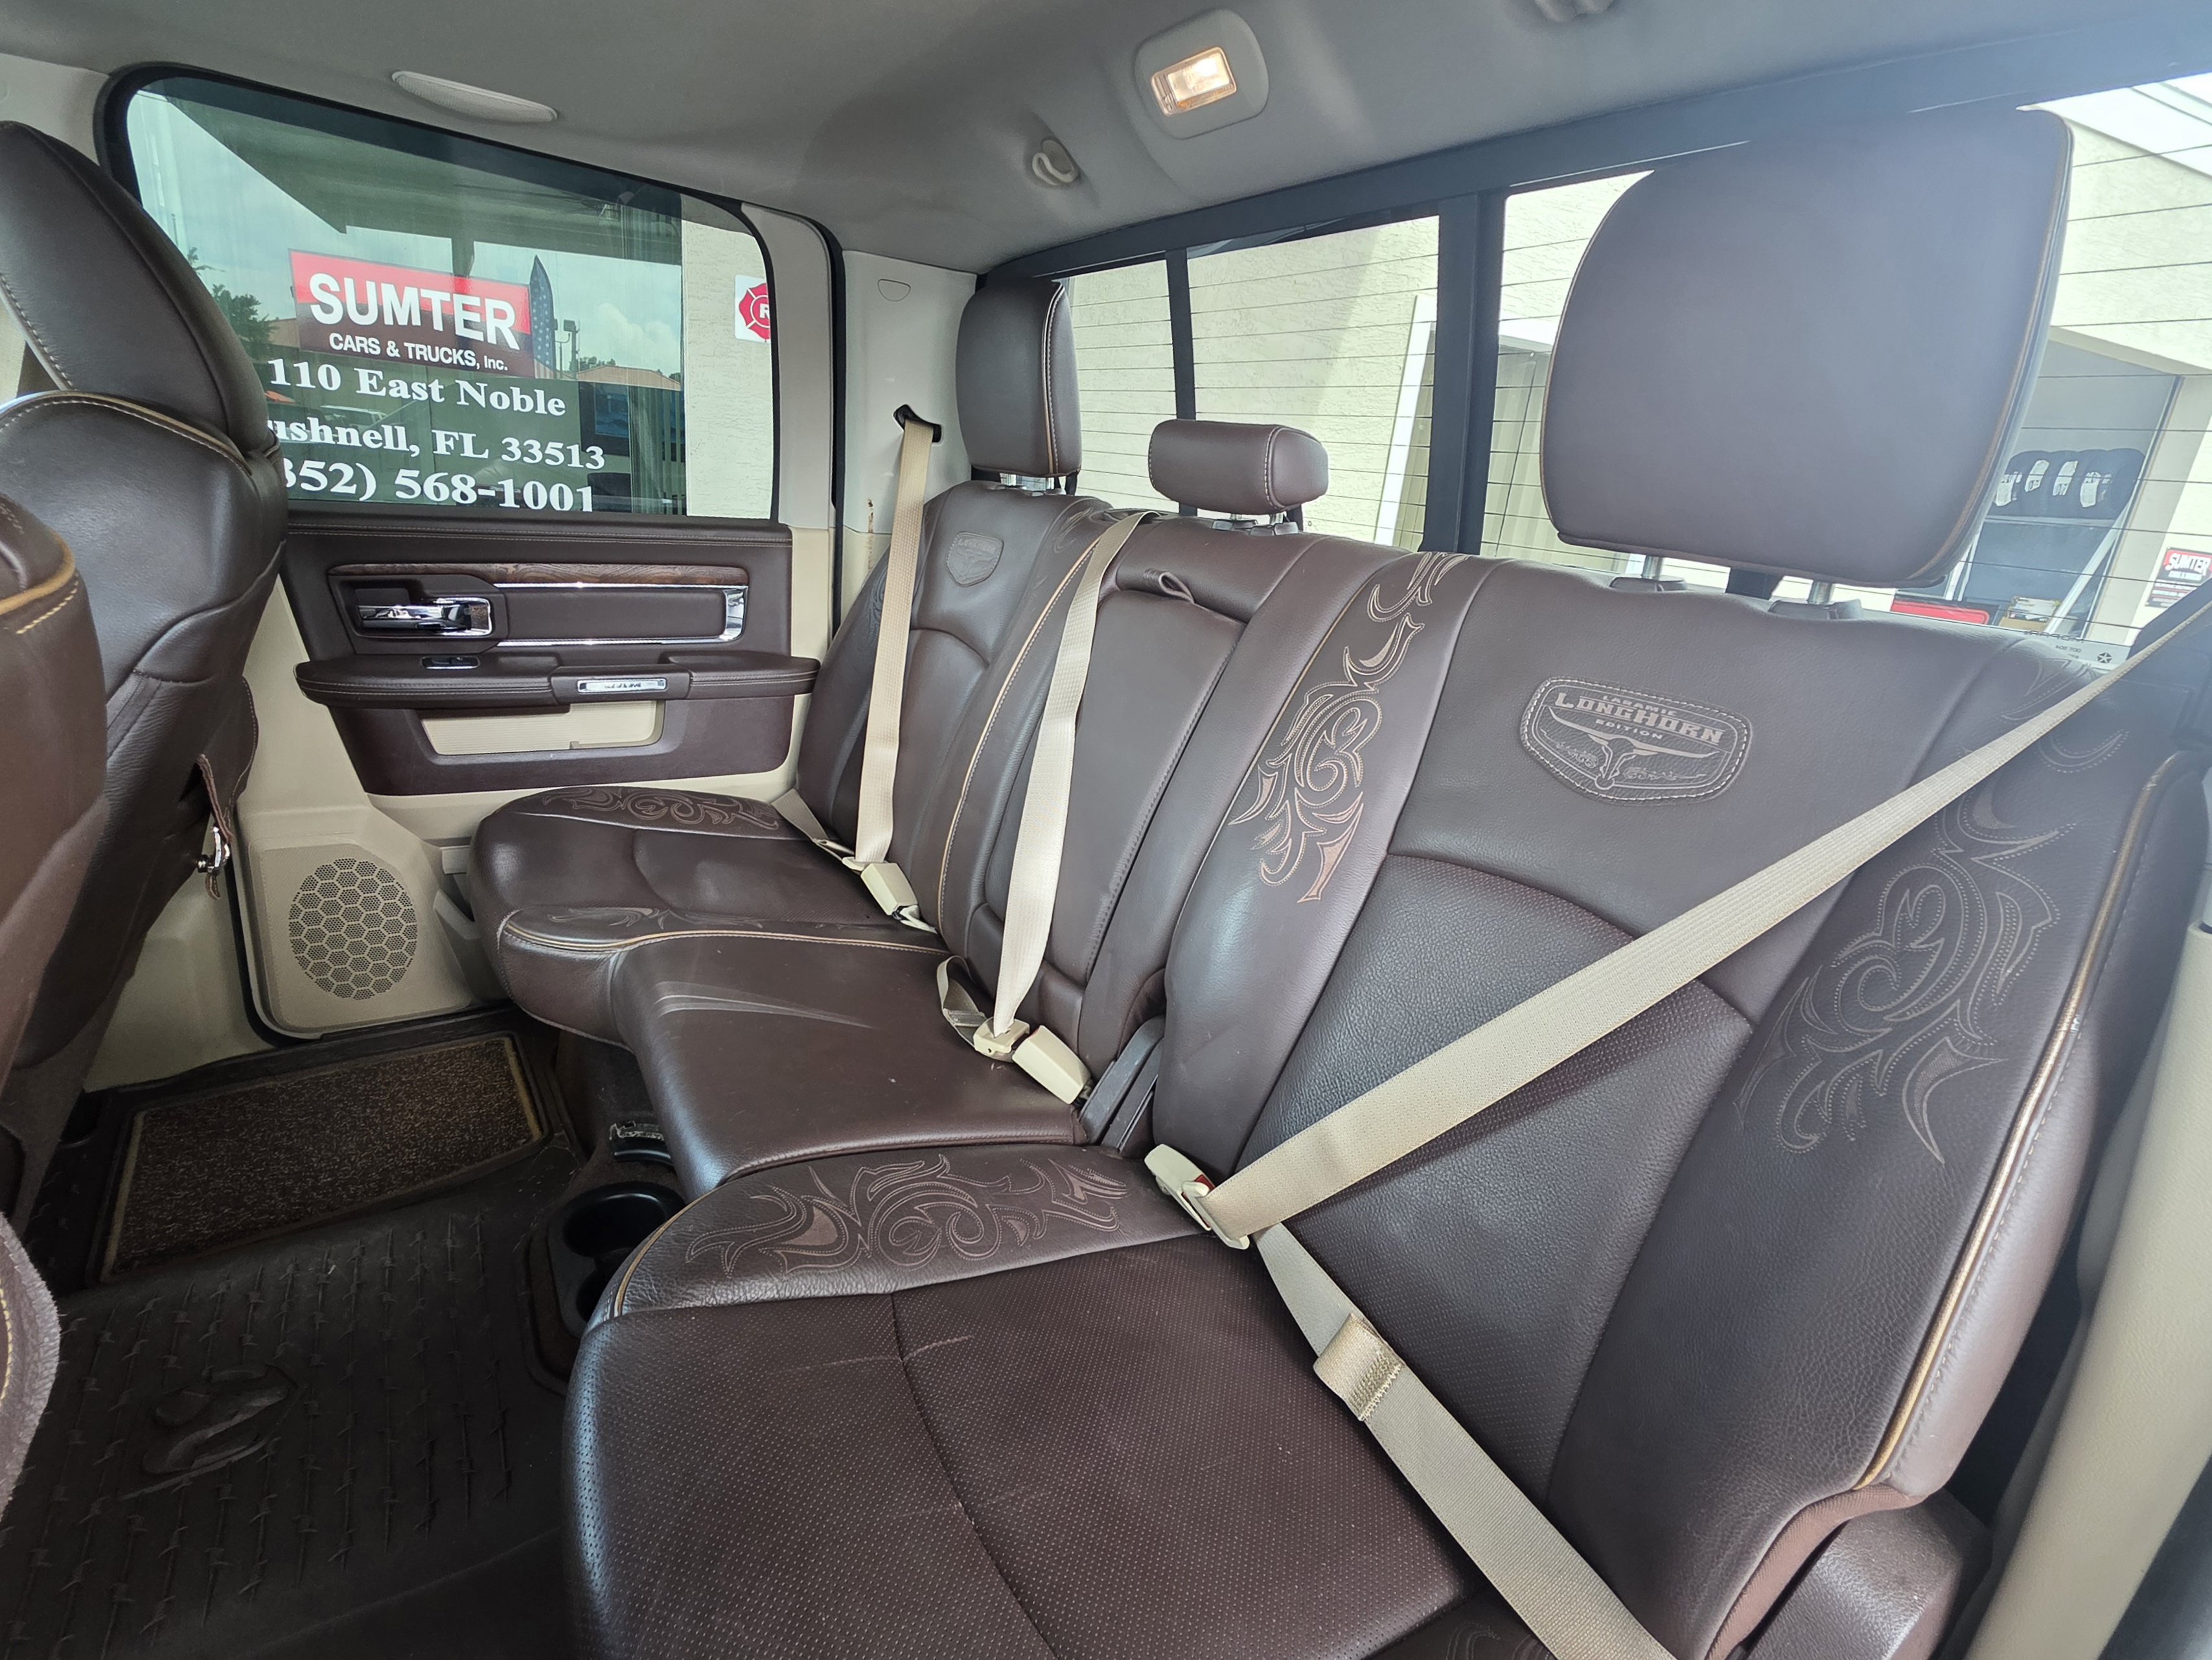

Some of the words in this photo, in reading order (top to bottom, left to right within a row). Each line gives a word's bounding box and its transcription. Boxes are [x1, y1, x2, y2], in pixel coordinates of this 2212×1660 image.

[309, 273, 520, 351] SUMTER
[329, 332, 381, 355] CARS
[386, 340, 400, 358] &
[403, 341, 480, 368] TRUCKS,
[484, 356, 508, 371] Inc.
[268, 358, 341, 391] 110
[353, 367, 445, 403] East
[455, 379, 566, 416] Noble
[267, 417, 421, 457] ushnell,
[432, 429, 489, 459] FL
[501, 436, 606, 470] 33513
[283, 457, 376, 501] 352)
[394, 468, 593, 512] 568-1001
[1554, 692, 1725, 743] LONGHORN
[1595, 719, 1663, 740] EDITION
[1602, 695, 1677, 717] LARAMIE
